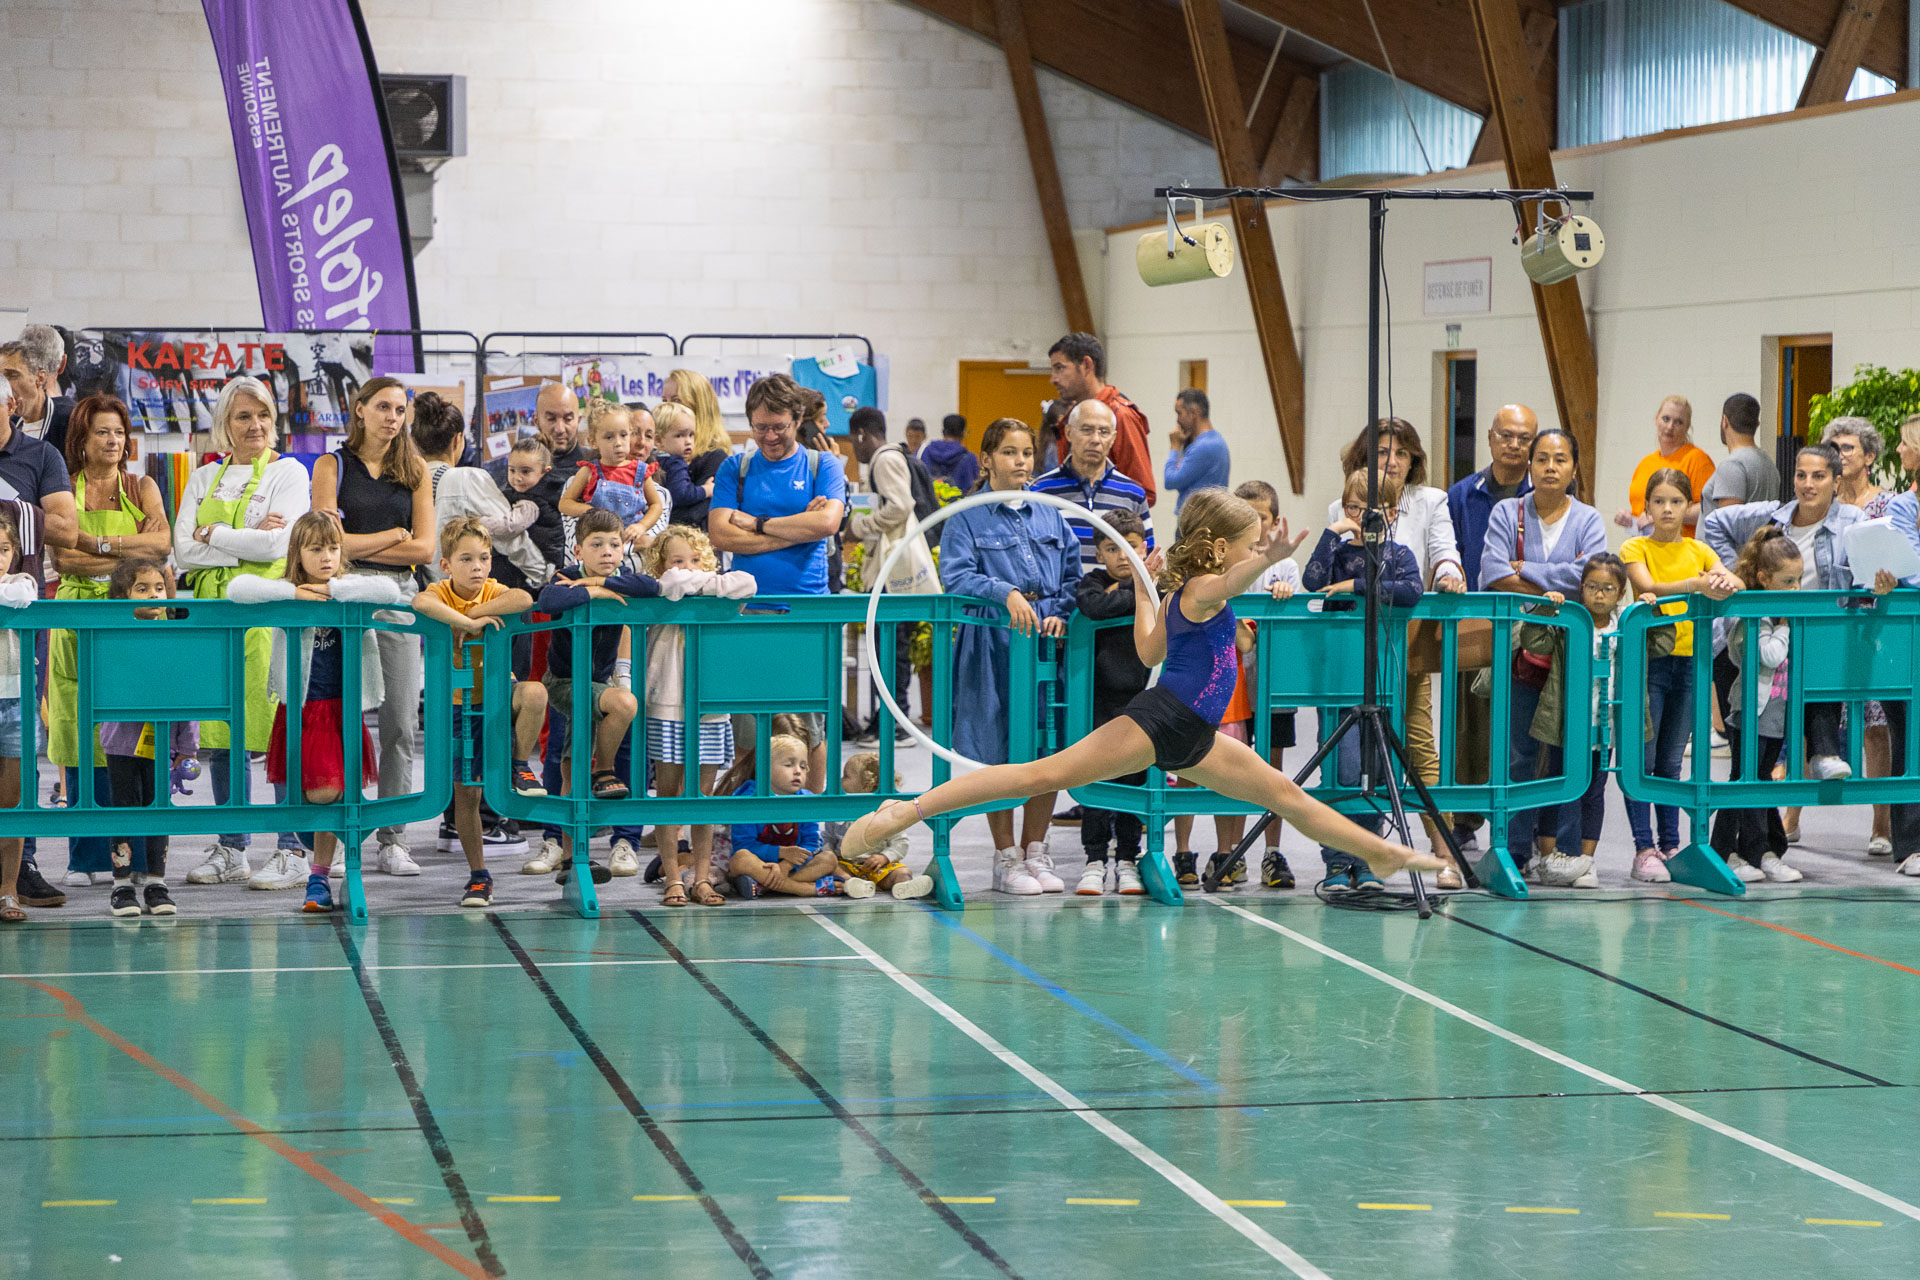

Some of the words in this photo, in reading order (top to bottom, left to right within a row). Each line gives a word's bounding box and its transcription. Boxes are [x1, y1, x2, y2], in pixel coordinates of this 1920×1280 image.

[127, 342, 284, 369] KARATE
[137, 377, 183, 391] Soisy
[189, 380, 217, 389] sur
[621, 374, 644, 396] Les
